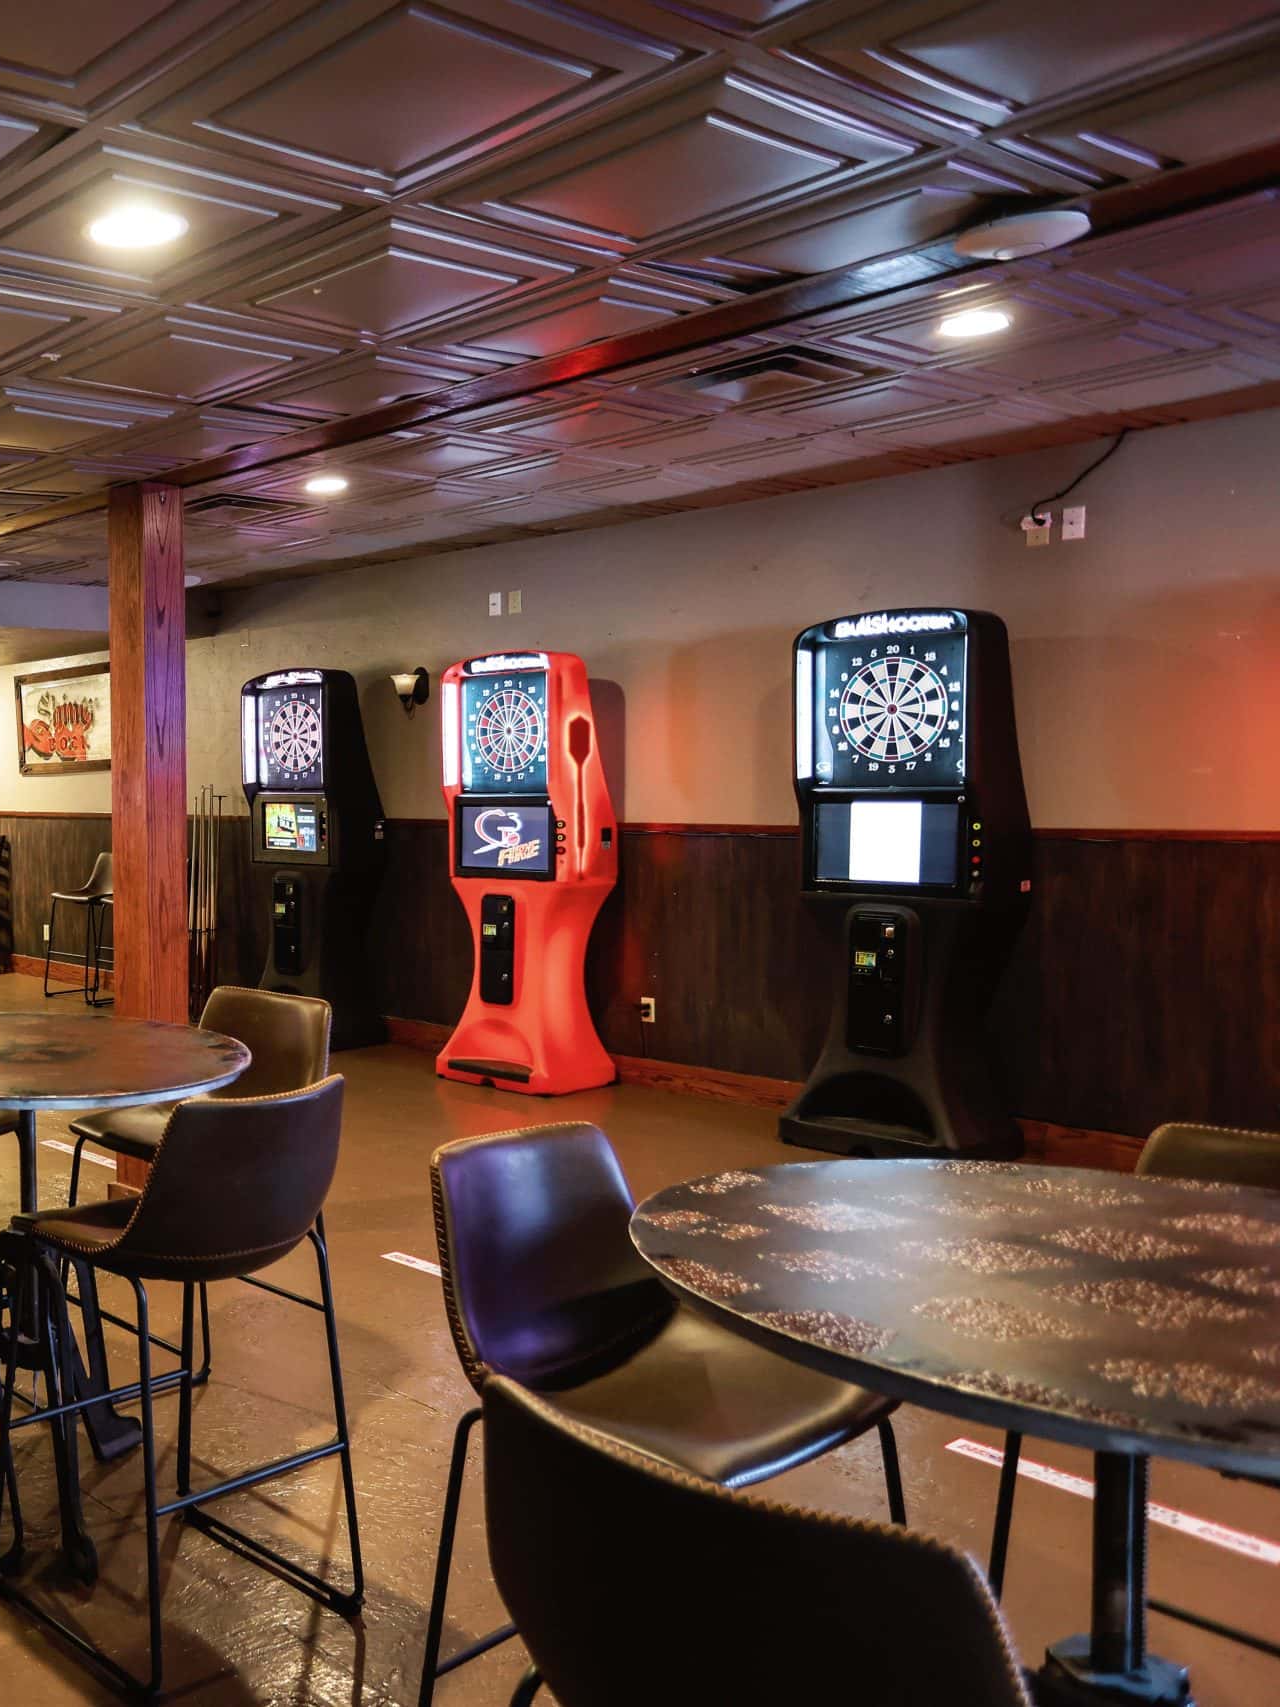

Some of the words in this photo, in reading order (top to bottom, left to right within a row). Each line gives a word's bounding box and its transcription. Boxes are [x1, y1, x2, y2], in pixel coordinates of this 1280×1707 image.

[886, 644, 900, 655] 20
[909, 645, 915, 655] 1
[939, 665, 948, 676] 4
[851, 754, 860, 764] 7
[905, 761, 917, 771] 17
[497, 839, 540, 867] FIRE
